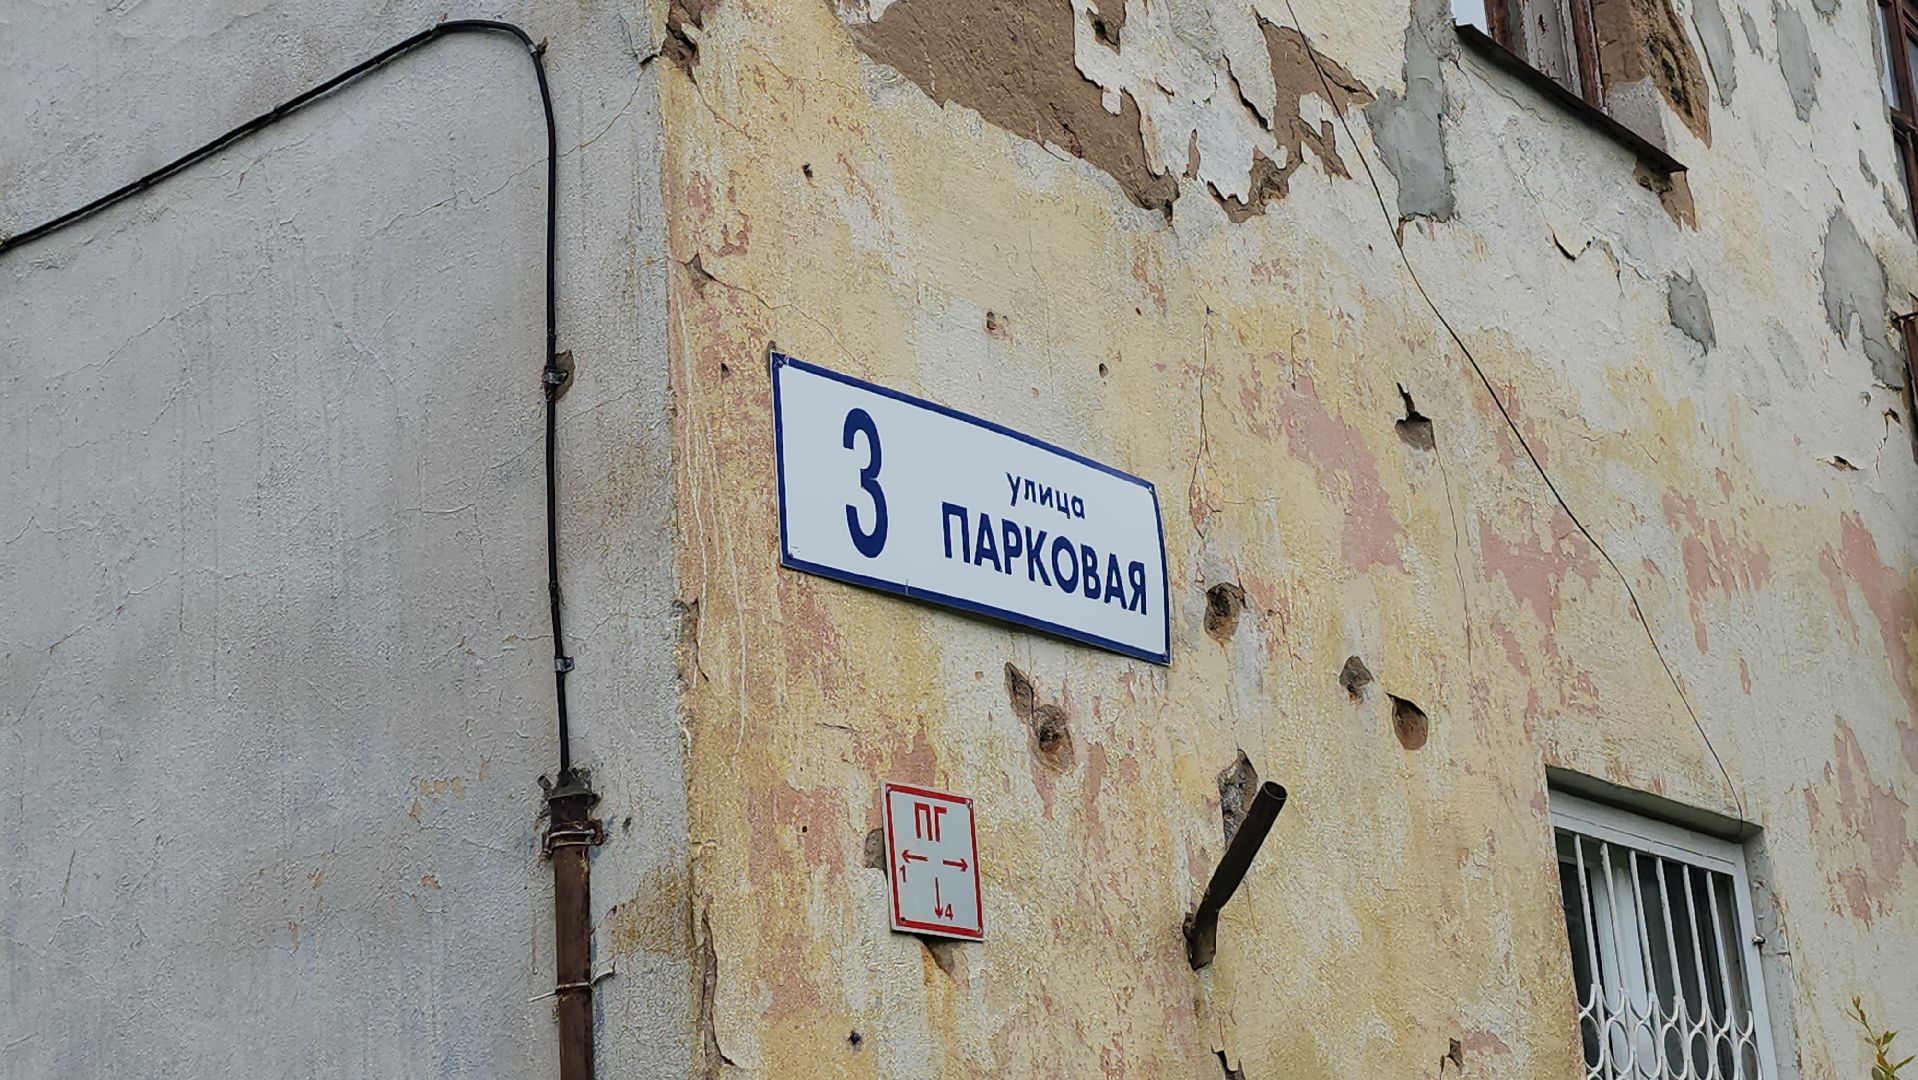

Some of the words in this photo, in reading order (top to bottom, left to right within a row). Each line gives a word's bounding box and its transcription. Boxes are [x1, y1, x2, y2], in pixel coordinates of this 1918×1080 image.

[842, 407, 888, 559] 3
[1005, 472, 1086, 520] улица
[941, 501, 1148, 616] ПАРКОВАЯ
[914, 801, 948, 842] ПГ
[899, 865, 907, 883] 1
[944, 903, 954, 921] 4
